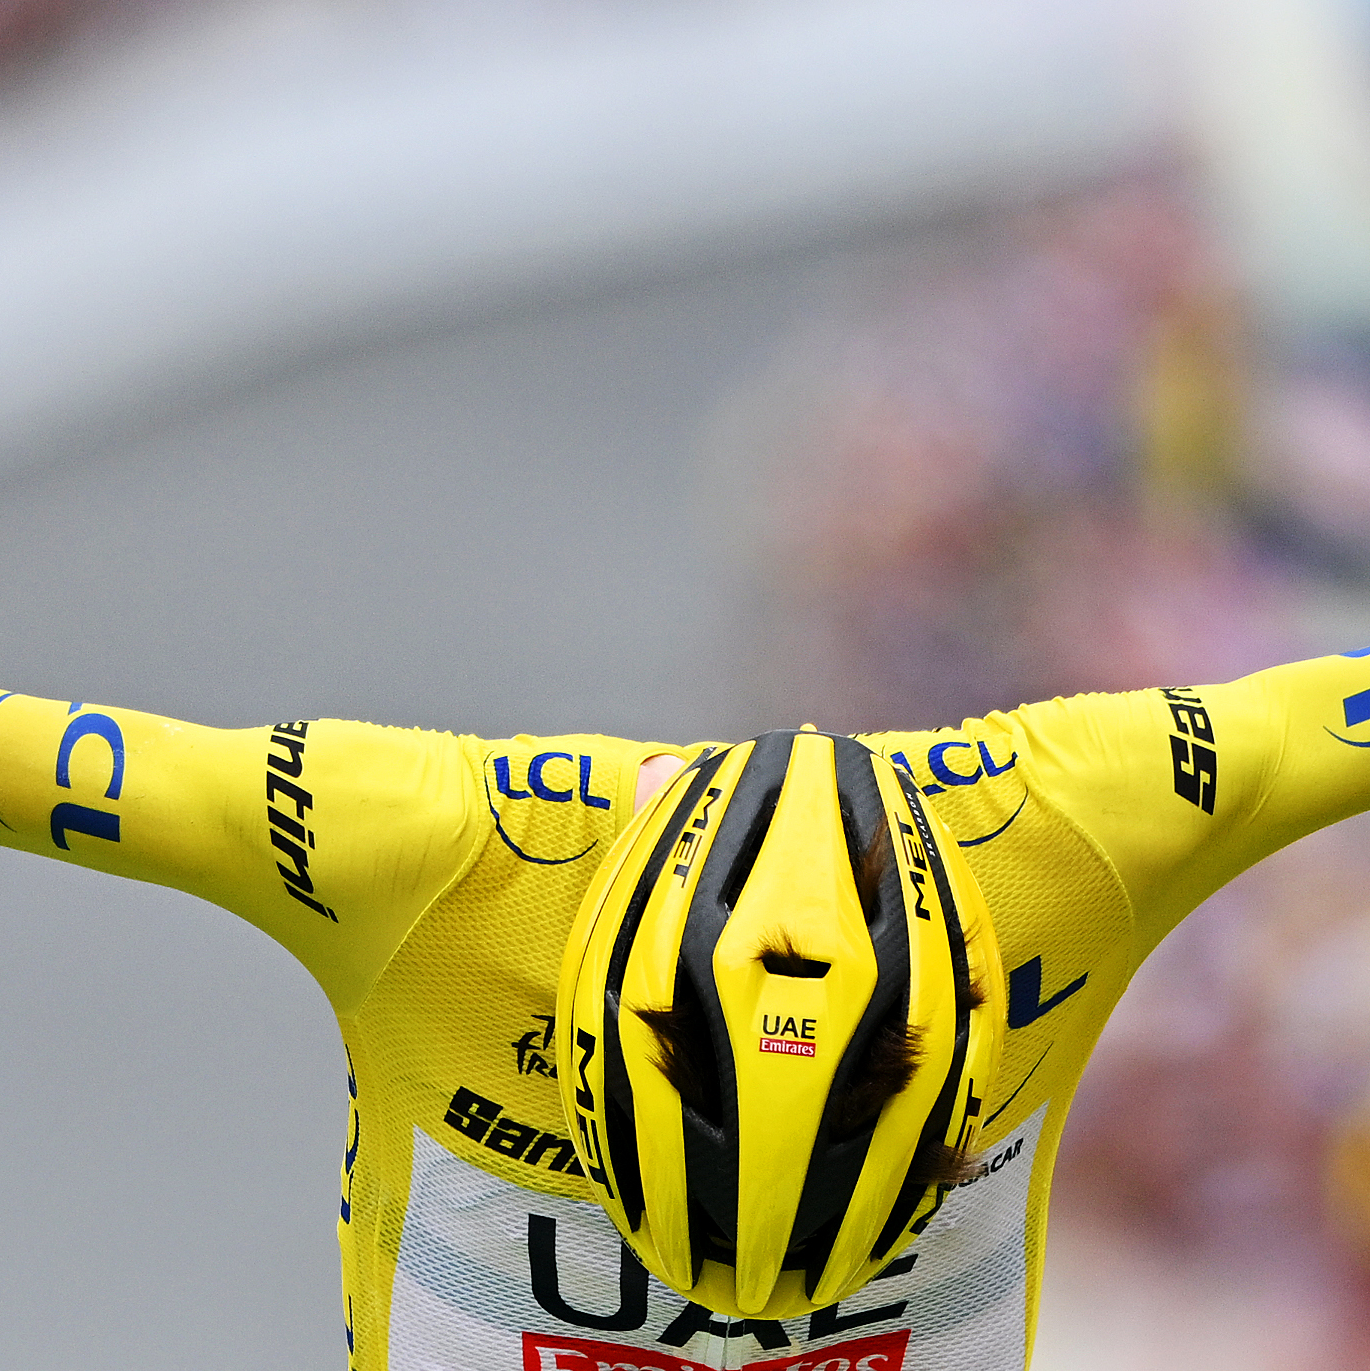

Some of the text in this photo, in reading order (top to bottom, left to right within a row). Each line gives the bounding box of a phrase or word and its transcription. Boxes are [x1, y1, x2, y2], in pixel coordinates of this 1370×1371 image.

[50, 701, 125, 852] CL
[266, 720, 339, 924] antini
[492, 751, 612, 811] LCL
[673, 787, 723, 889] MET
[893, 811, 931, 922] MET
[760, 1038, 815, 1056] Emirates
[762, 1014, 817, 1040] UAE
[575, 1027, 616, 1200] MET
